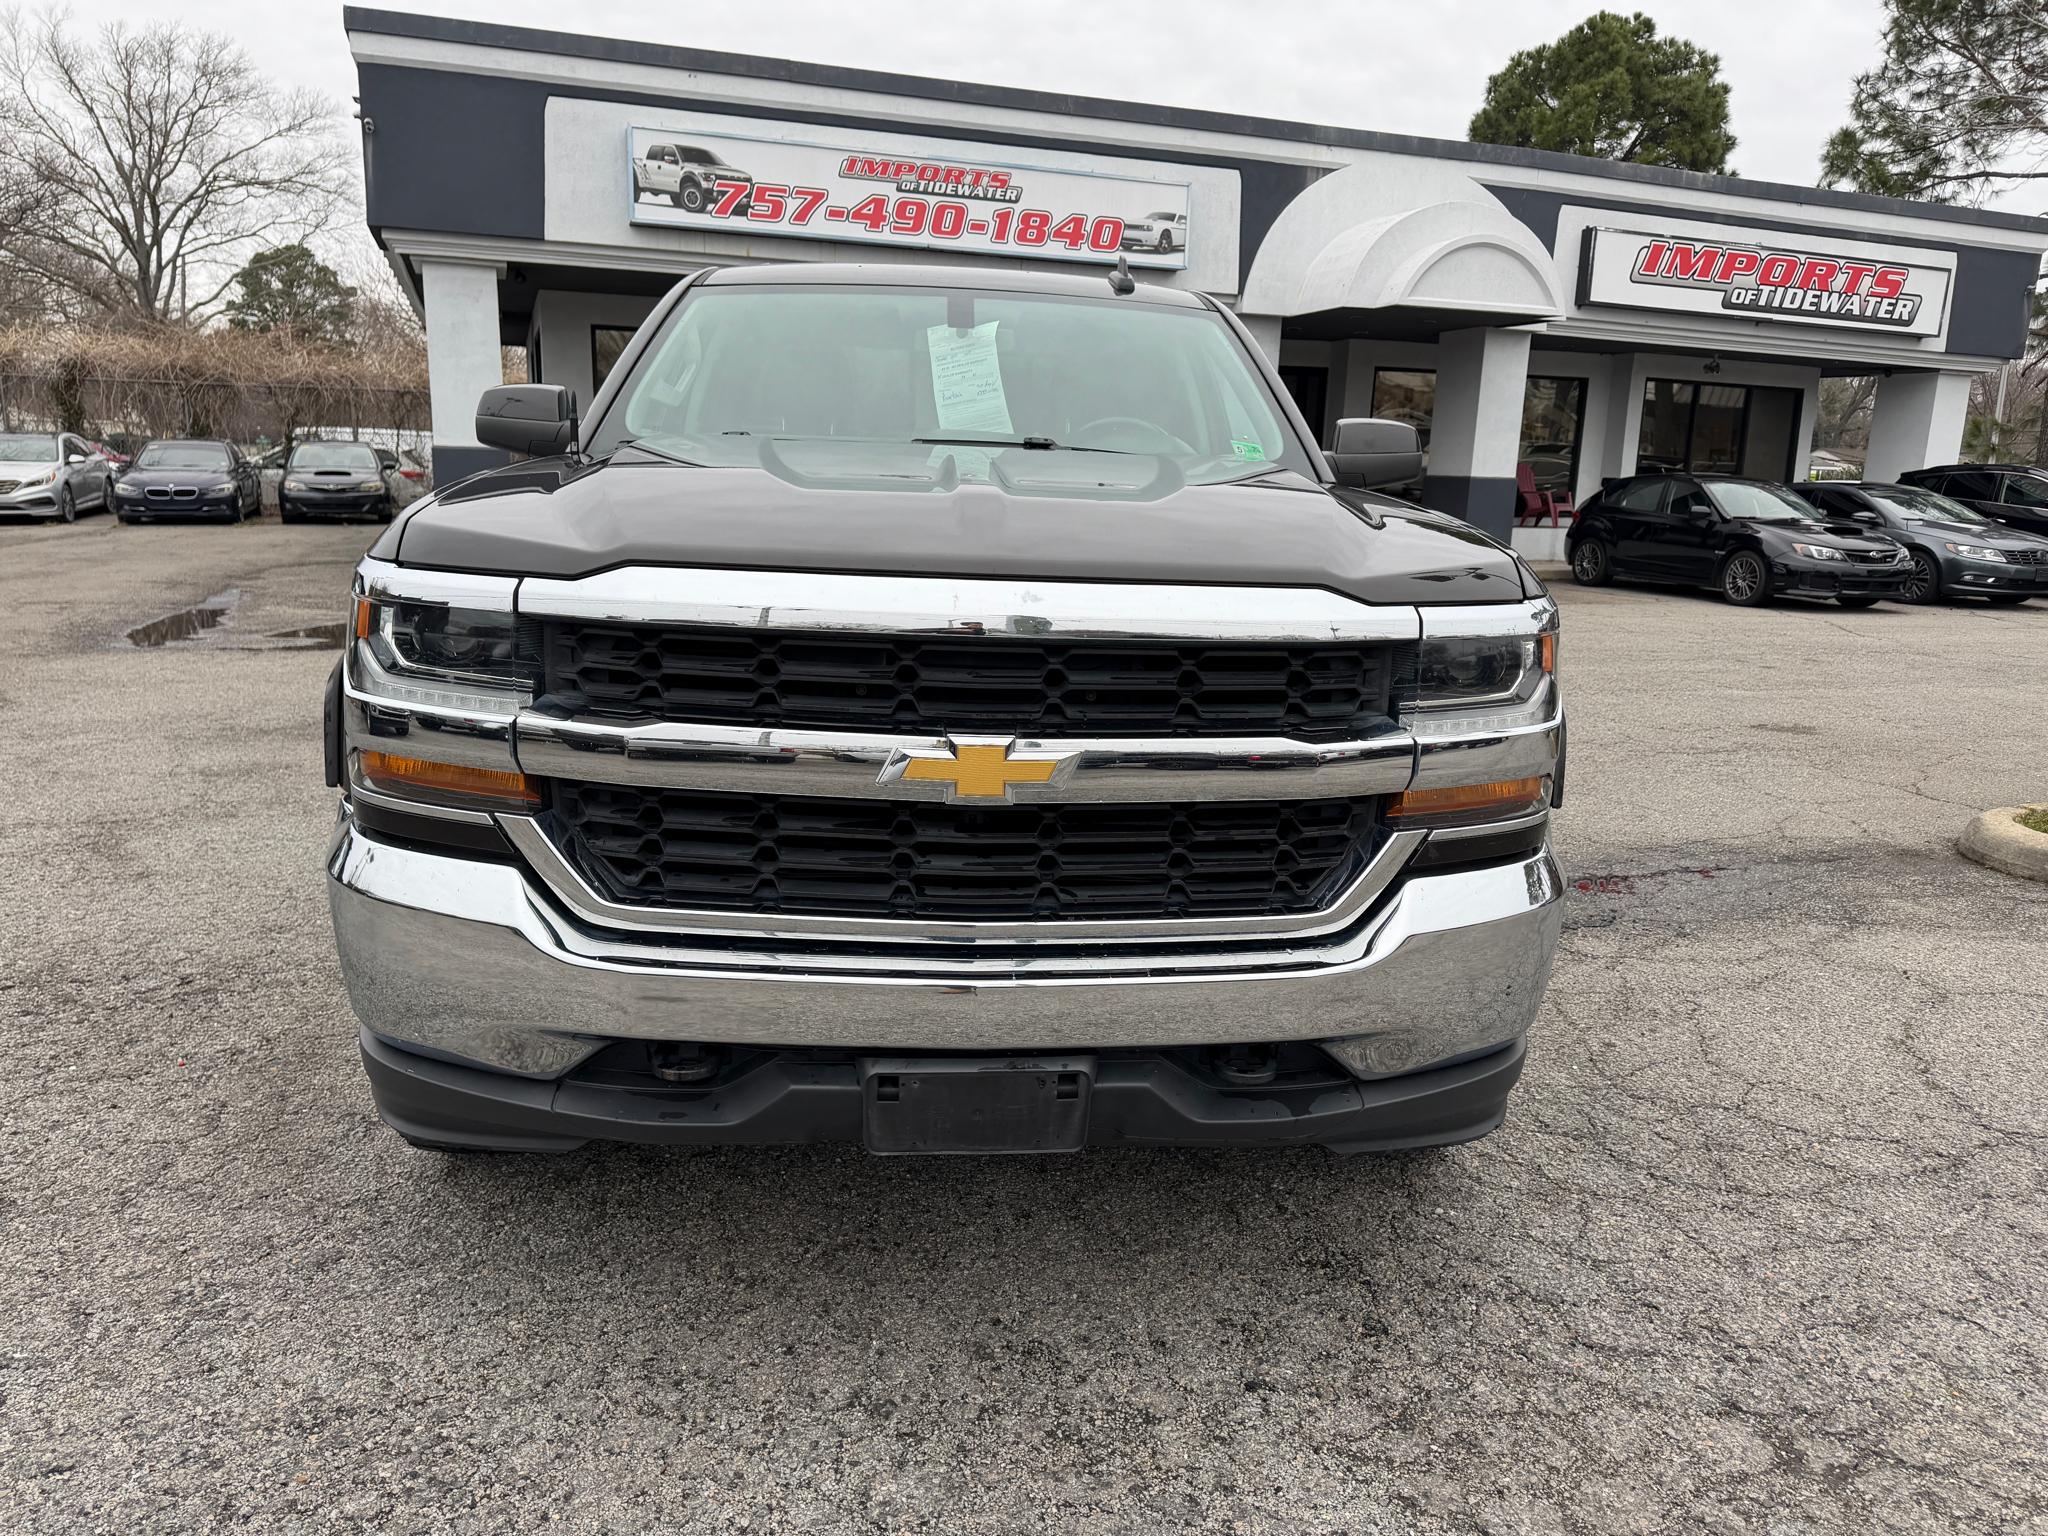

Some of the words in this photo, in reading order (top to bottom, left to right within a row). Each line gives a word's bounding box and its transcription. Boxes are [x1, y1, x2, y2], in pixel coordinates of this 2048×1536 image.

[844, 156, 1013, 189] IMPORTS
[902, 181, 917, 191] OF
[917, 179, 1019, 201] TIDEWATER
[710, 180, 1127, 253] 757-490-1840
[1638, 240, 1910, 299] IMPORTS
[1729, 287, 1758, 306] OF
[1756, 283, 1915, 322] TIDEWATER
